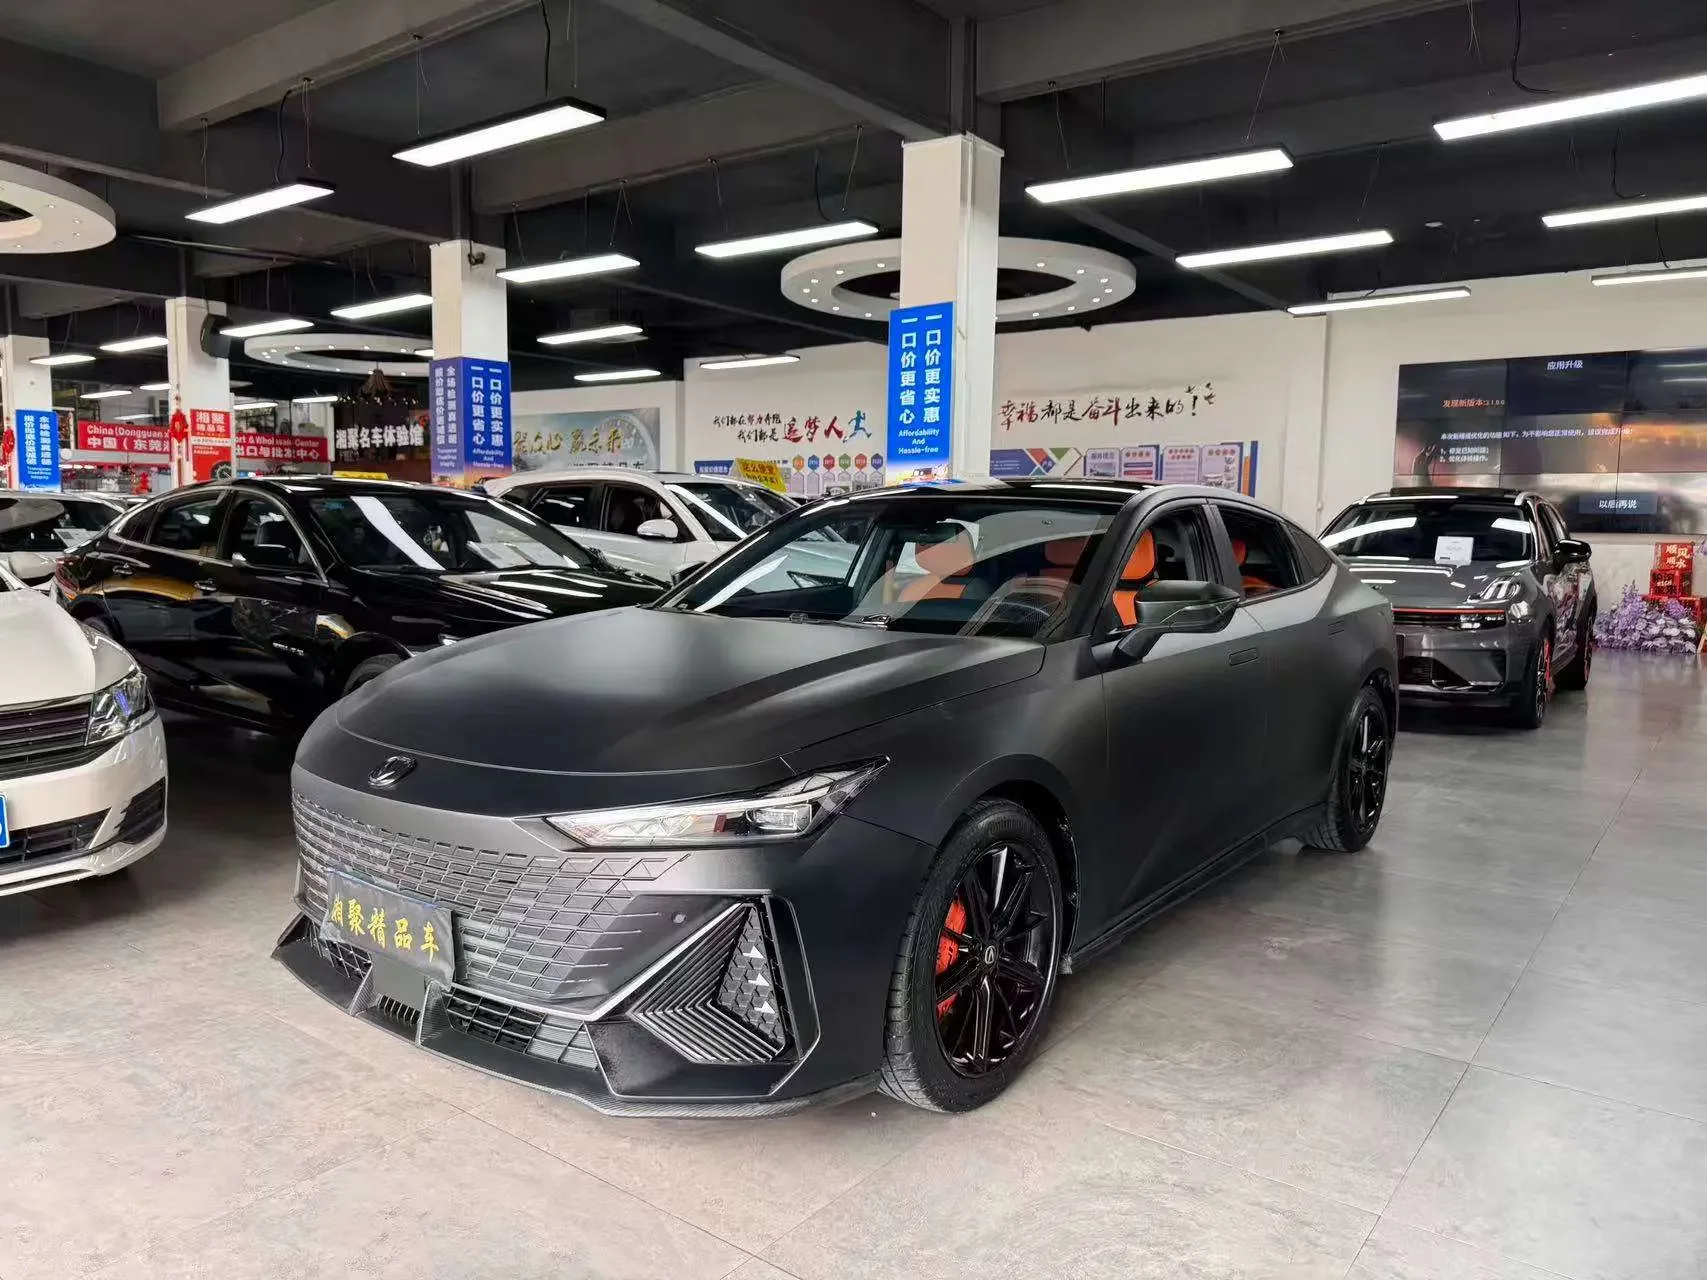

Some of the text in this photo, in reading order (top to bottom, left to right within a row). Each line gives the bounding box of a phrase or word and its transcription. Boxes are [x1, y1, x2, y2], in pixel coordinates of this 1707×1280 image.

[899, 316, 919, 425] 一口价更省心
[923, 313, 943, 423] 一口价更实惠
[1546, 359, 1584, 370] 应用升级
[470, 365, 486, 446] 一口价更省心
[488, 367, 504, 447] 一口价更实惠
[712, 411, 782, 428] 我们都在努力奔跑
[86, 424, 114, 434] China
[736, 415, 844, 445] 我们都是 追梦人
[899, 428, 940, 438] Affordability
[898, 447, 939, 455] Hassle-free
[1598, 499, 1639, 509] 以后再说
